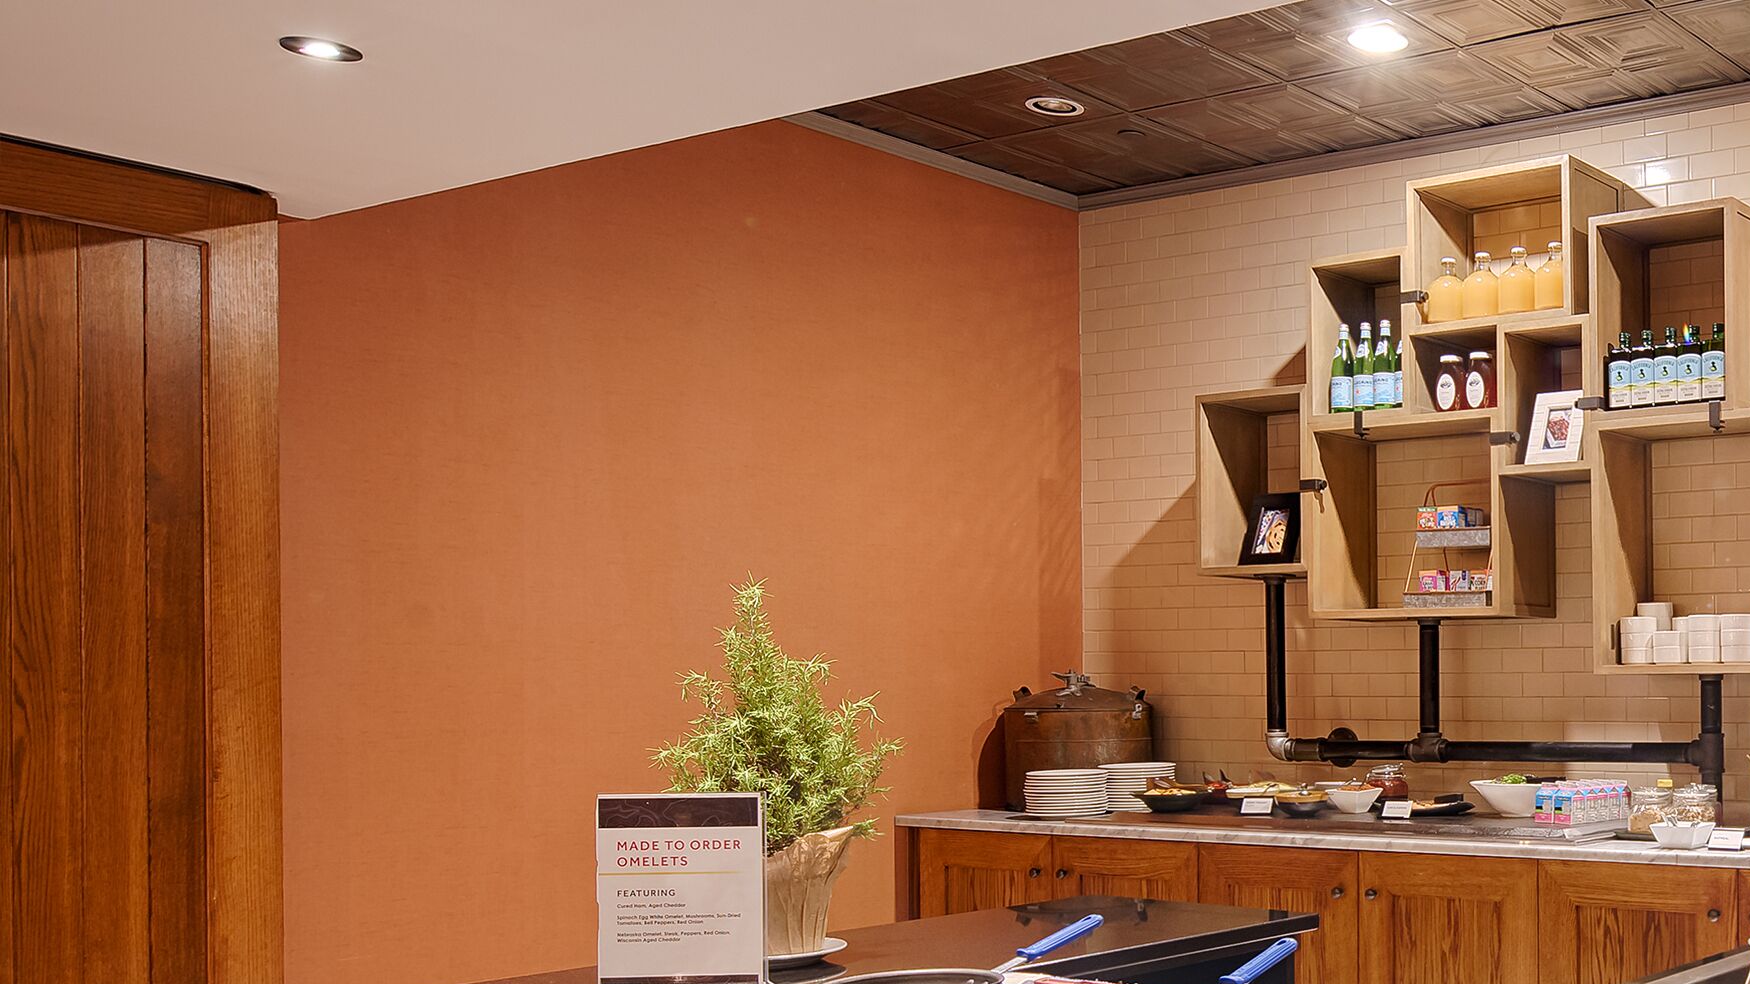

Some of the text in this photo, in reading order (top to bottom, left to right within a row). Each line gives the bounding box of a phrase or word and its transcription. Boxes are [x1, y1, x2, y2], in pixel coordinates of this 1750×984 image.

[616, 839, 742, 851] MADE TO ORDER
[616, 856, 689, 867] OMELETS
[617, 889, 676, 897] FEATURING
